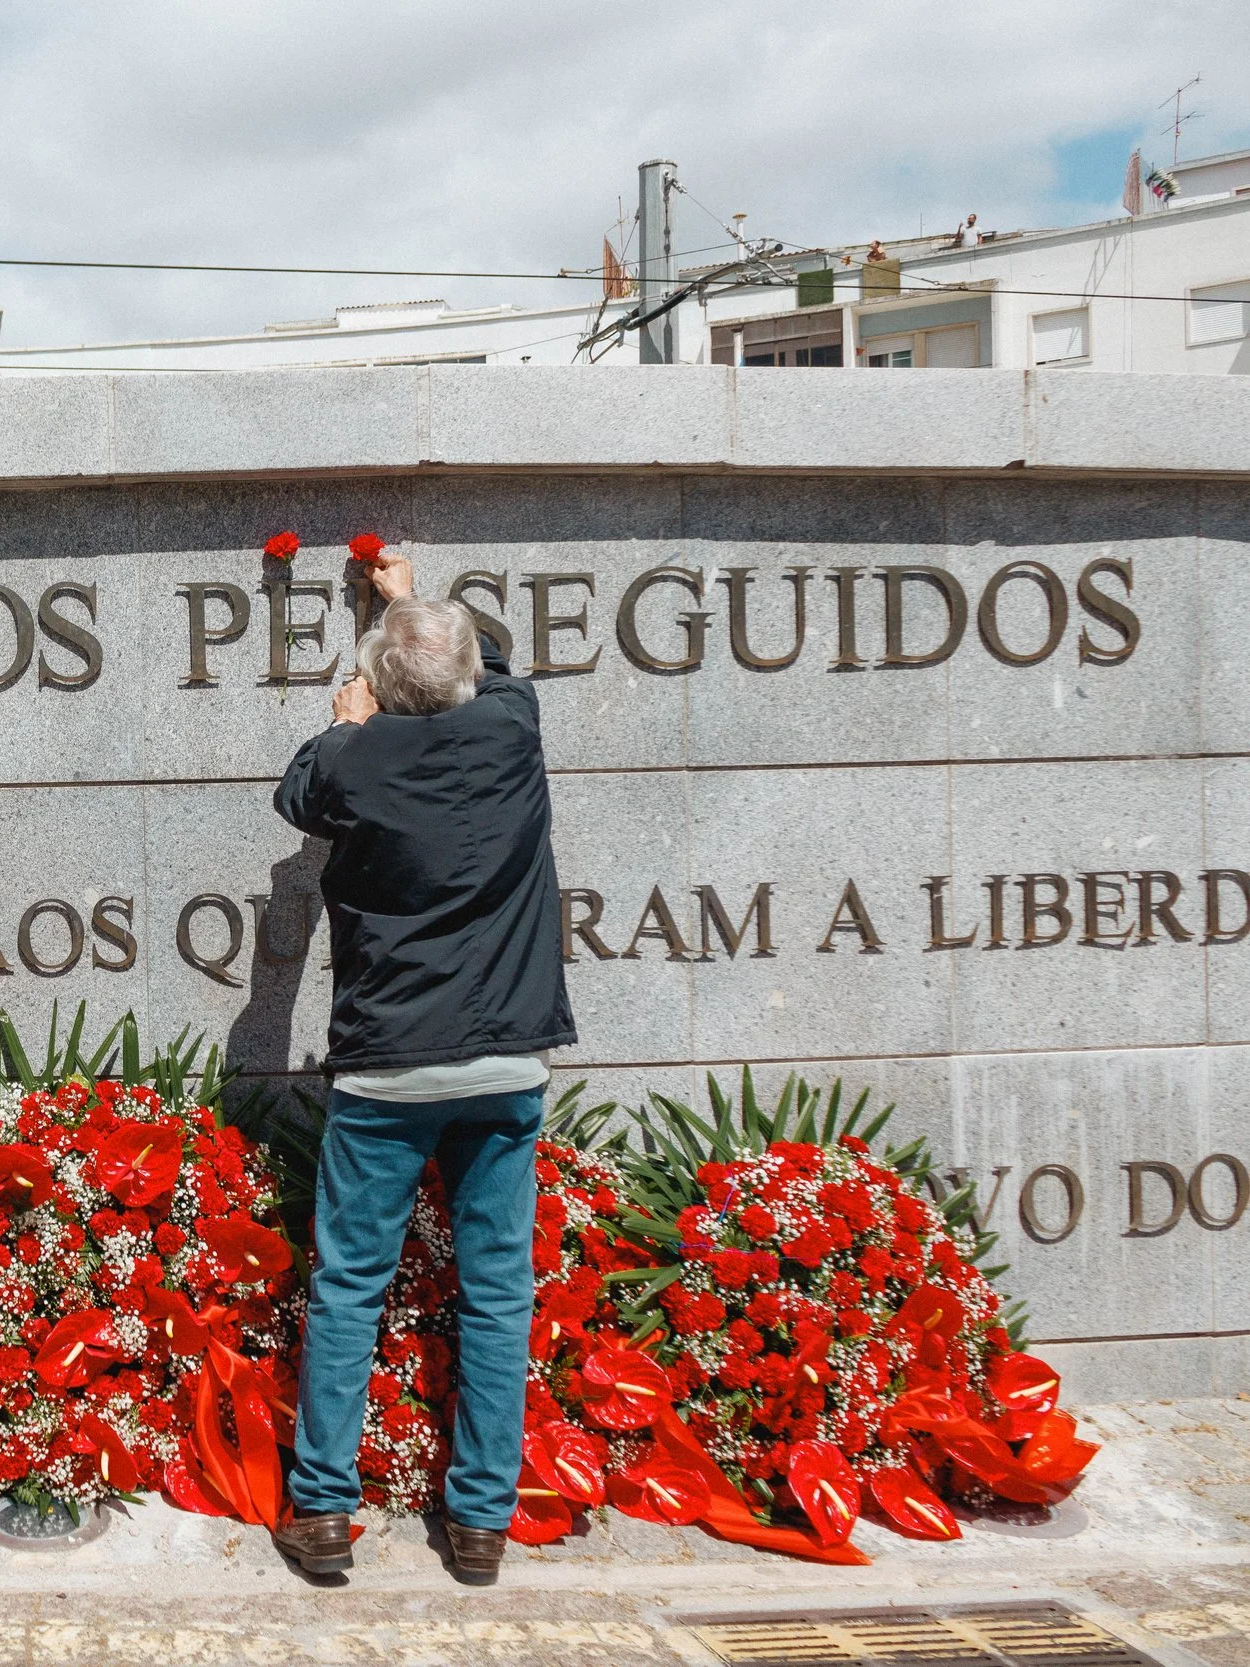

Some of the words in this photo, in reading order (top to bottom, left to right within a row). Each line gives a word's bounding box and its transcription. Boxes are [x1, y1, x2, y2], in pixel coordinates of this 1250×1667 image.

[175, 892, 334, 988] QU
[558, 881, 780, 965] RAM
[815, 877, 888, 955] A
[1118, 1153, 1250, 1238] DO
